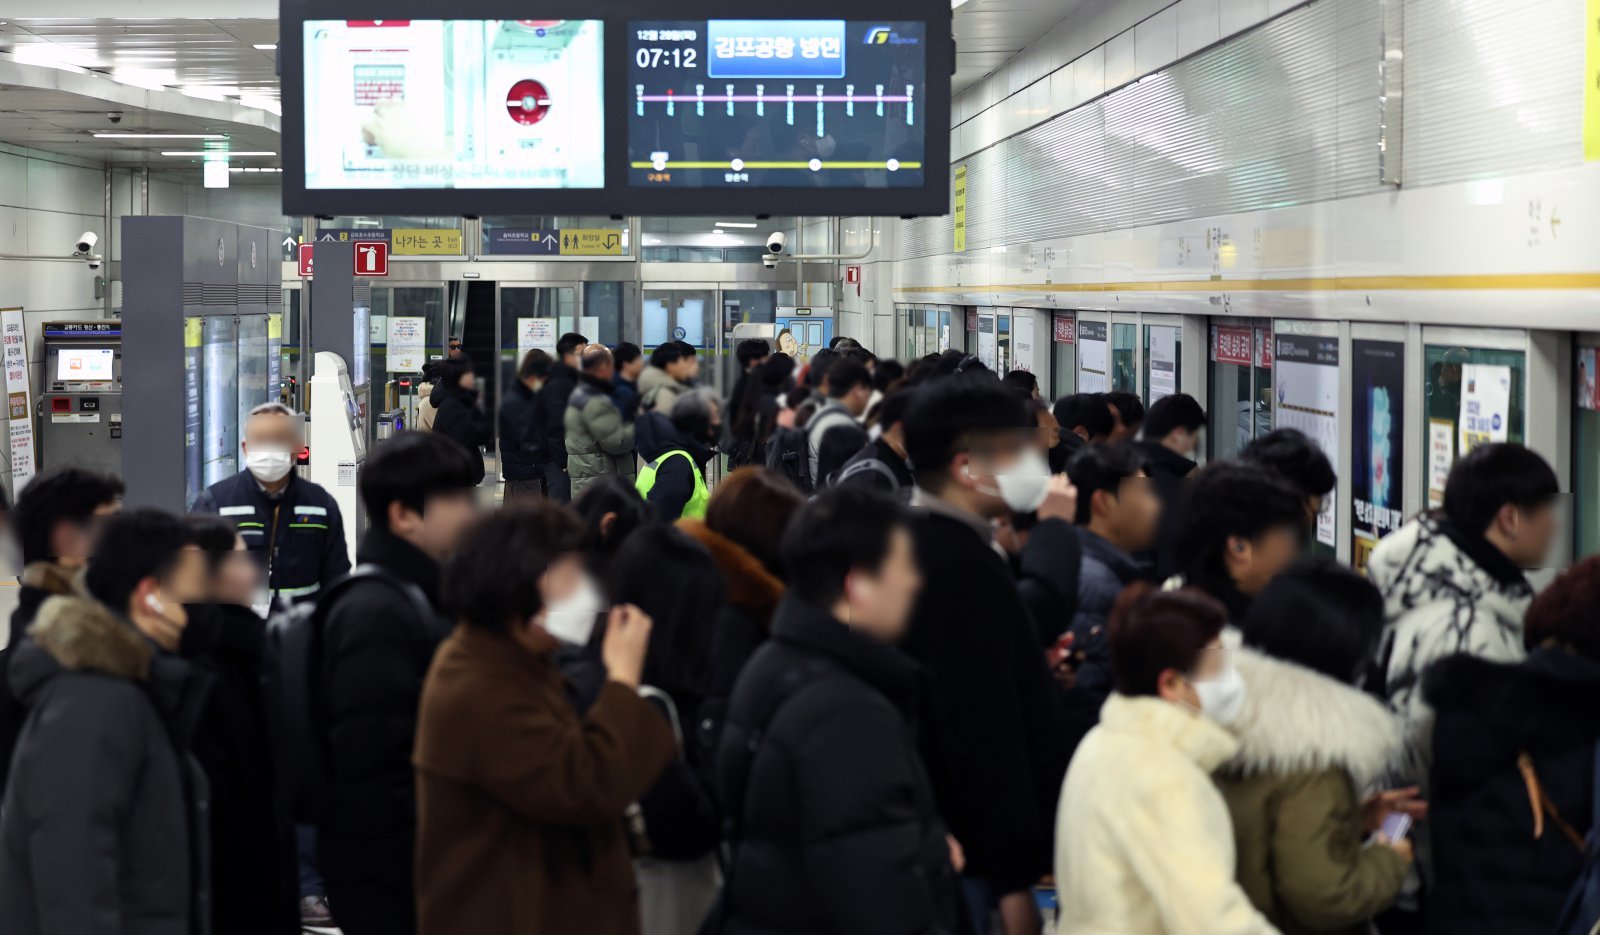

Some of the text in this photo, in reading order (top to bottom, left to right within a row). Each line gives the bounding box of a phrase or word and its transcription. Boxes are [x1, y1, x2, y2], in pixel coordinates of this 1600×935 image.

[636, 47, 697, 68] 07:12
[715, 36, 841, 59] 김포공항 방면
[392, 164, 421, 180] 상단
[395, 236, 443, 249] 나가는 곳
[1219, 334, 1250, 359] 무리한 승차 금지
